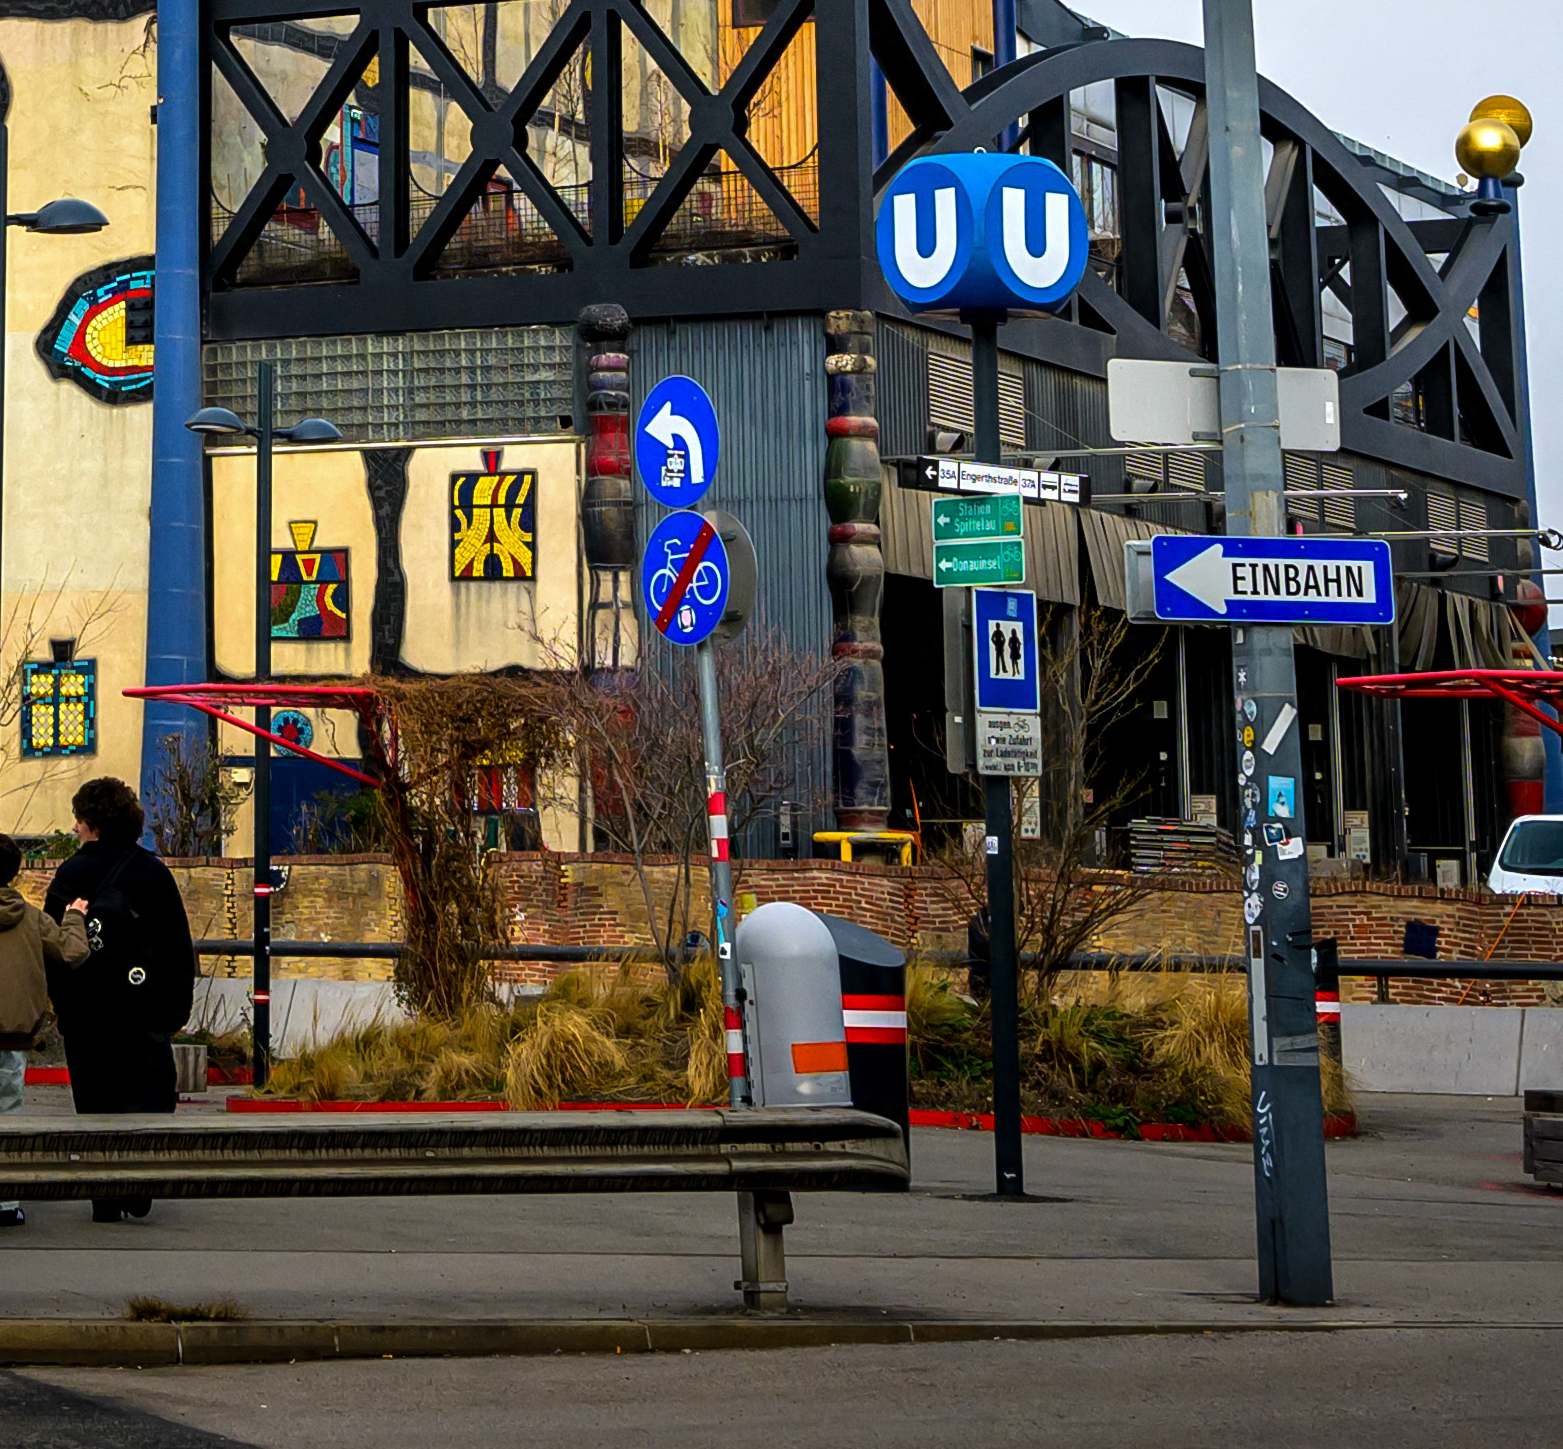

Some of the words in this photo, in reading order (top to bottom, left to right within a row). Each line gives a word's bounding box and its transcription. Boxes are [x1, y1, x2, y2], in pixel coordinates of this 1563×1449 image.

[893, 187, 957, 289] U
[1002, 186, 1070, 289] U
[939, 469, 957, 481] 35A
[960, 469, 1019, 487] Engerthstraße
[1021, 477, 1037, 490] 37A
[958, 501, 992, 517] Station
[954, 516, 997, 536] Spittelau
[951, 554, 1002, 573] Donauinsel
[1231, 562, 1365, 598] EINBAHN
